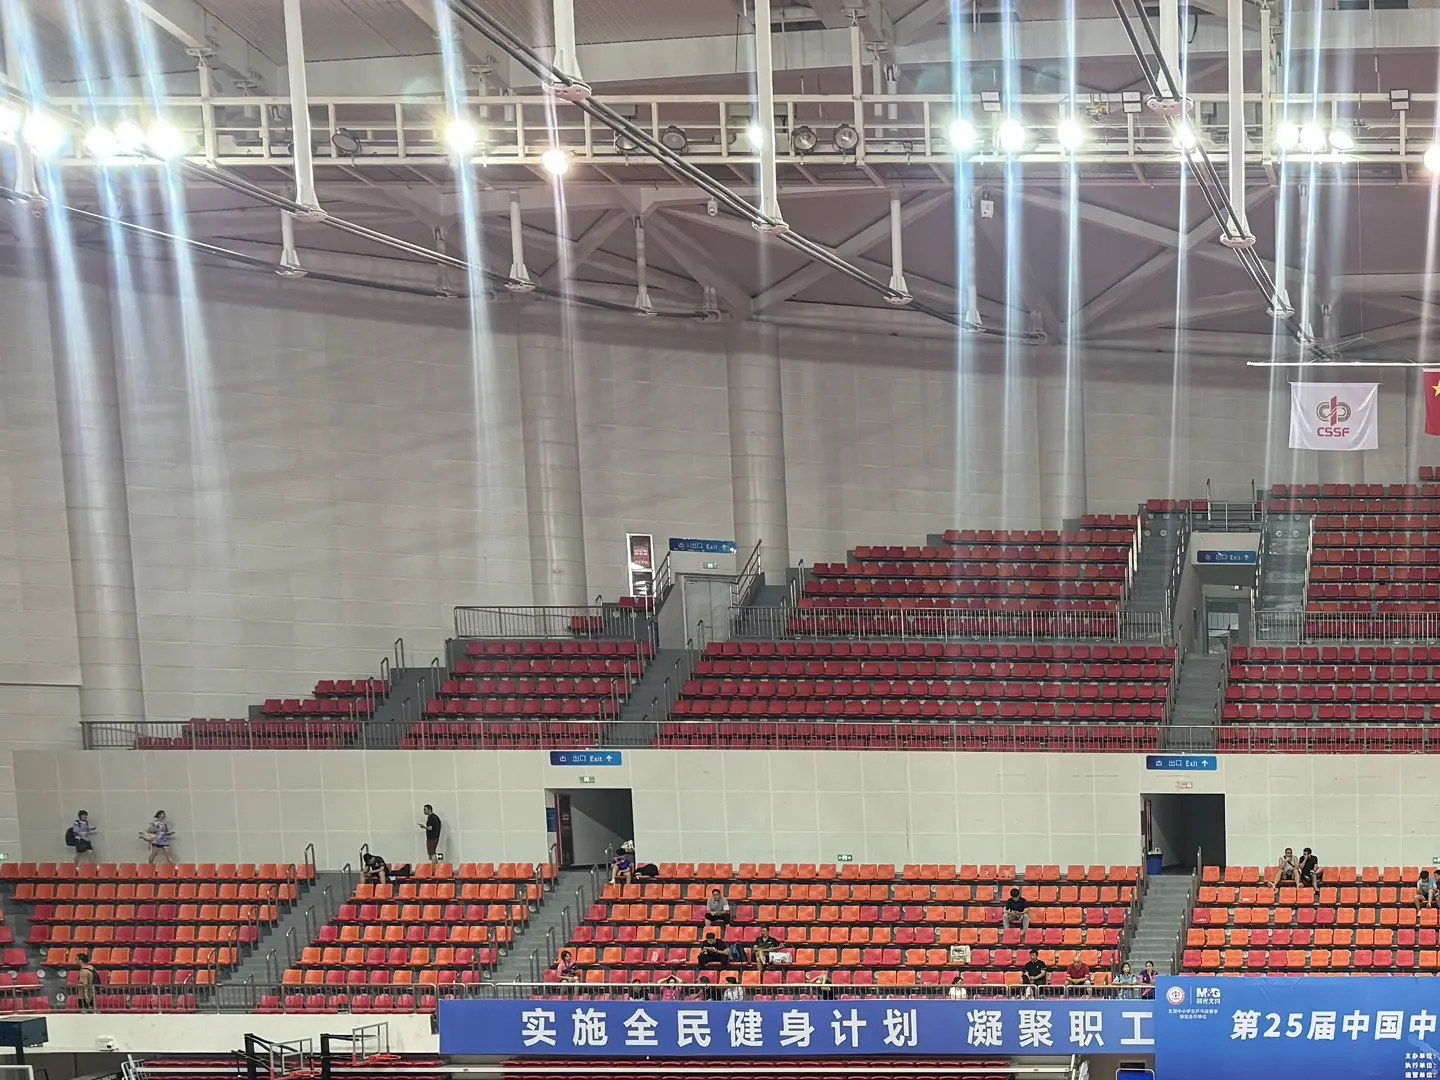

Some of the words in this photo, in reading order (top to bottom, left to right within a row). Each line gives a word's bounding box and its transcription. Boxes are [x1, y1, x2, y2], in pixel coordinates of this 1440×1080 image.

[1317, 427, 1350, 438] CSSF
[572, 754, 586, 762] 出口
[1196, 987, 1220, 998] M&G
[522, 1008, 917, 1047] 实施全民健身计划
[967, 1010, 1154, 1047] 凝聚职工
